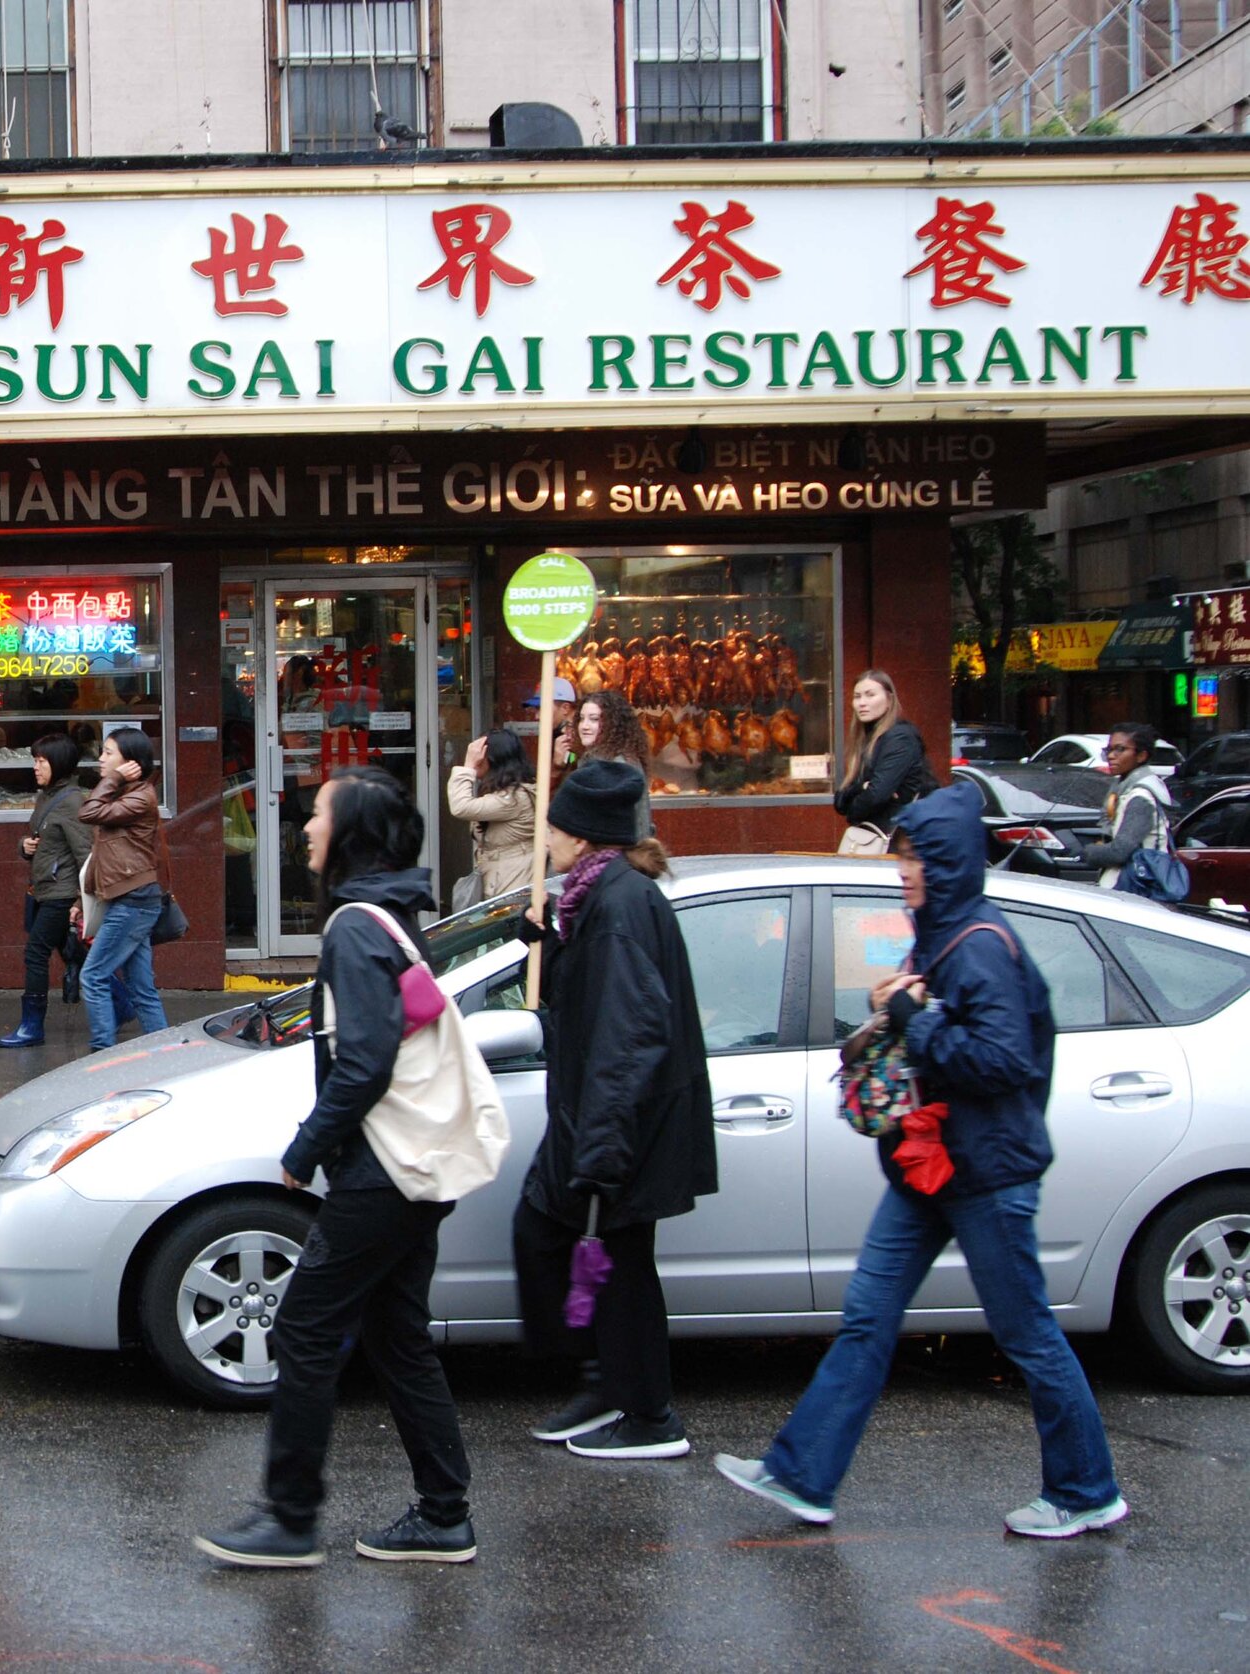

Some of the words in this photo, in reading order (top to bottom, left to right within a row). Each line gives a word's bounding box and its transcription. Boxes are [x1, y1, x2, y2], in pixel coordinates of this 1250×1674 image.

[187, 339, 336, 399] SAI
[393, 336, 544, 396] GAI
[588, 325, 1148, 391] RESTAURANT
[922, 434, 996, 464] HEO
[167, 450, 286, 519] TÂN
[753, 481, 828, 511] HEO
[839, 473, 940, 509] CÚNG
[538, 557, 567, 568] CALL
[27, 590, 132, 620] 中西包點
[508, 604, 541, 617] 1000
[543, 601, 587, 615] STEPS
